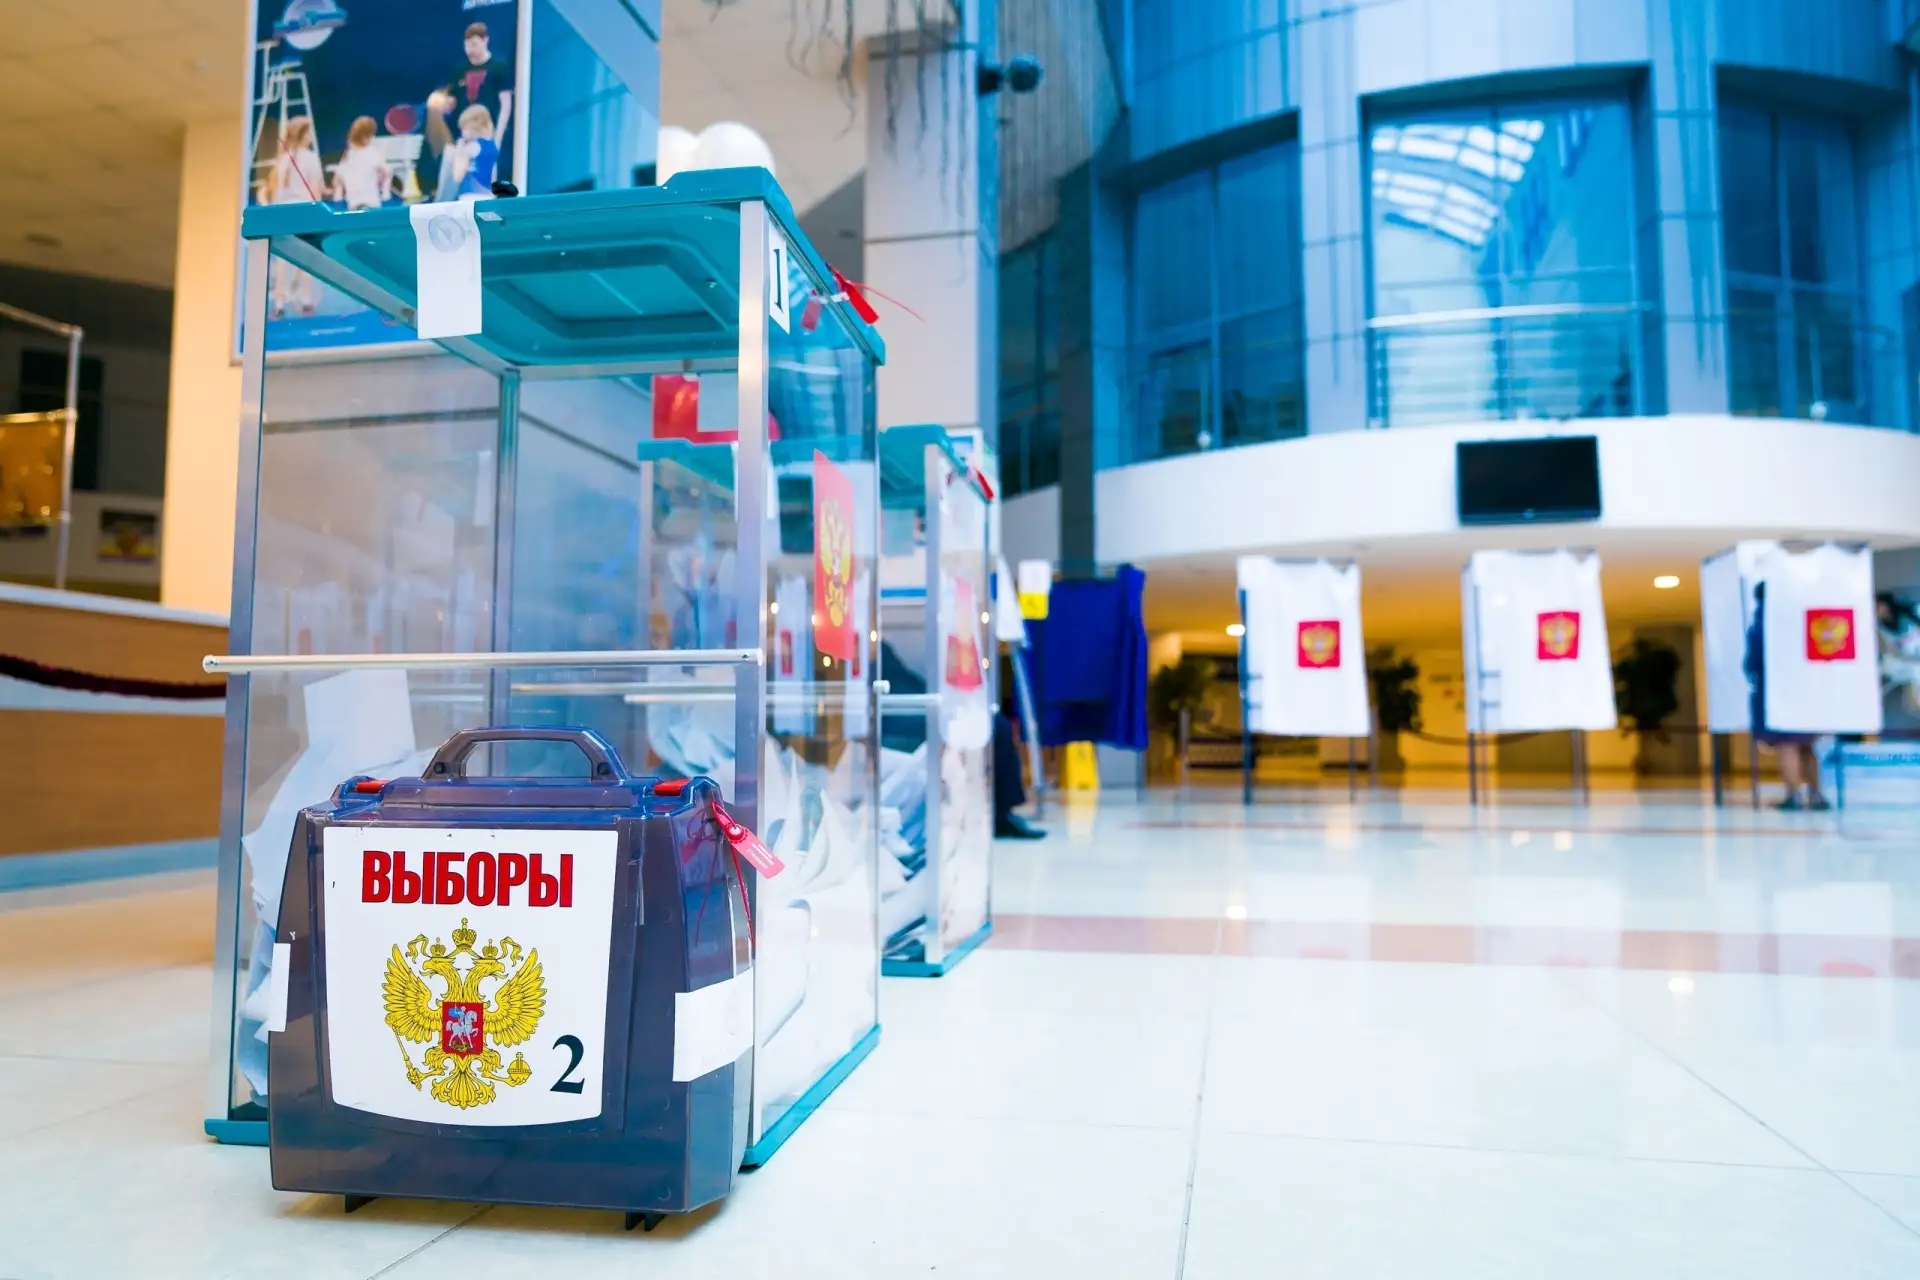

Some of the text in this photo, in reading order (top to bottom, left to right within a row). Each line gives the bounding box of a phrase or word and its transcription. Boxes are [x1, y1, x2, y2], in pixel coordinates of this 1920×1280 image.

[773, 248, 784, 314] 1
[361, 850, 574, 907] ВЫБОРЫ
[550, 1034, 585, 1094] 2
